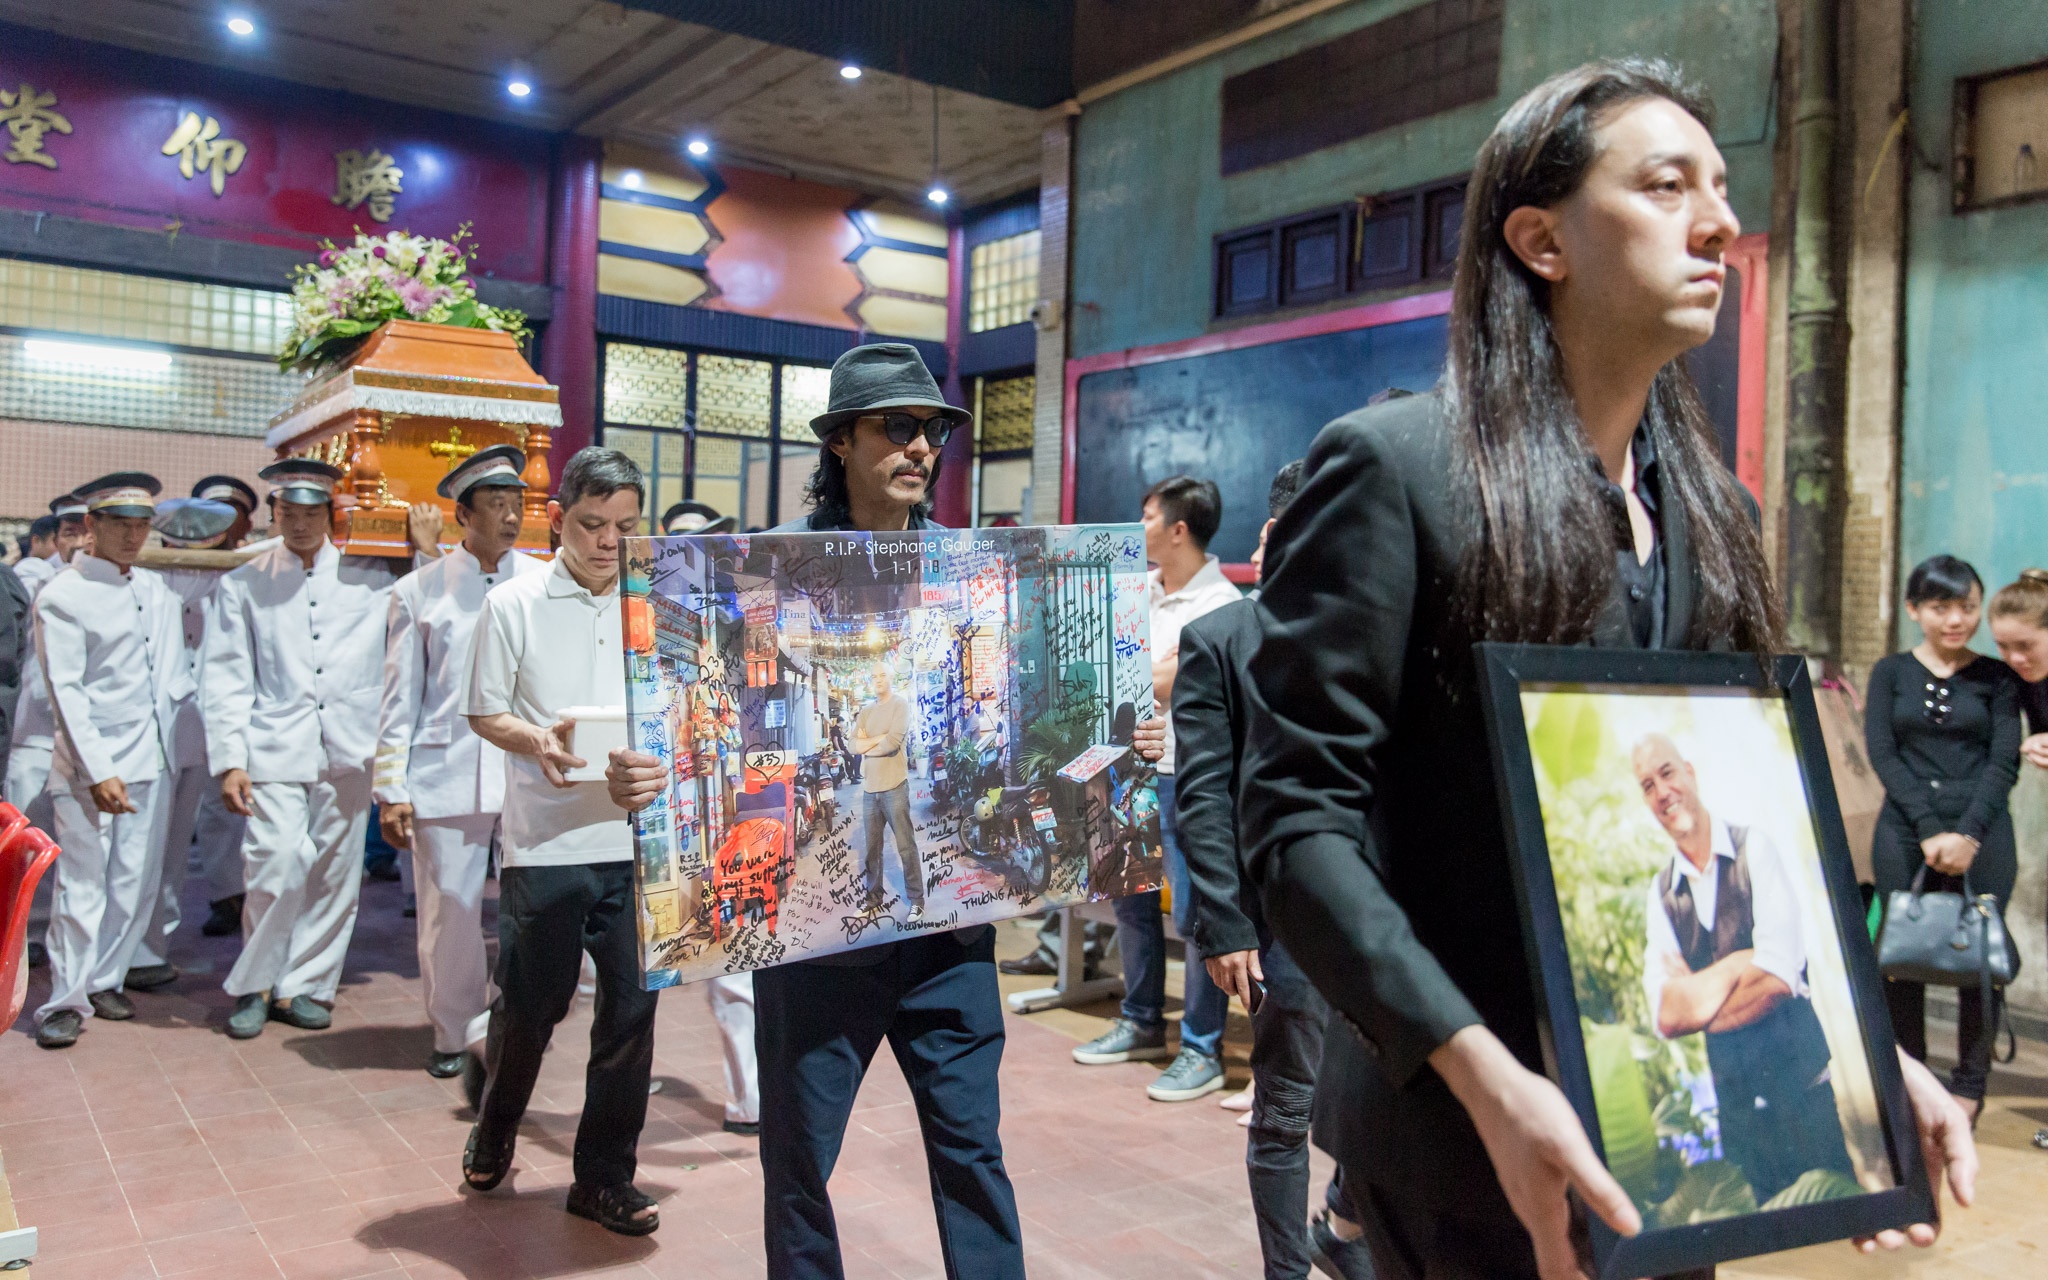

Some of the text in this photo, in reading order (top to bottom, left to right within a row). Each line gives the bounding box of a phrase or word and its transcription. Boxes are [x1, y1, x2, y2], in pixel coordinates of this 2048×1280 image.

[825, 538, 995, 557] R.I.P. Stephane Gauger
[782, 608, 807, 619] Tina
